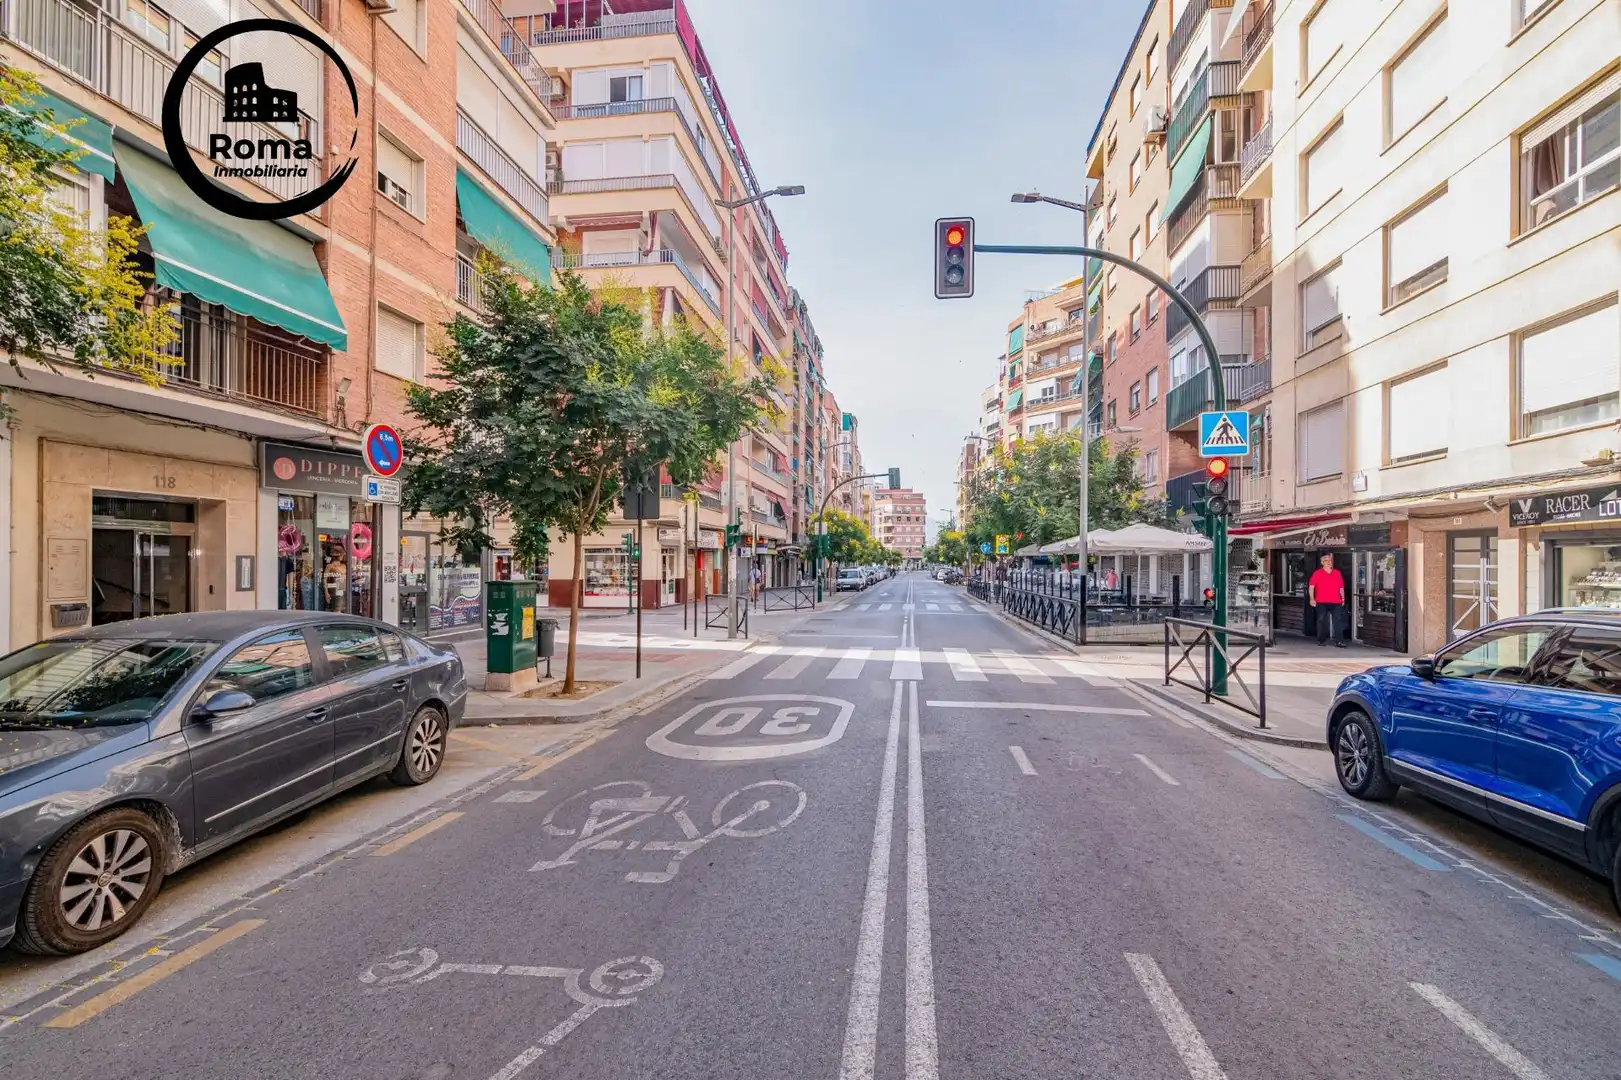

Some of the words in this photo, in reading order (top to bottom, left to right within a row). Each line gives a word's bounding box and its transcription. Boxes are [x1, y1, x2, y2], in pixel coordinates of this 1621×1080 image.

[152, 475, 177, 489] 118
[1545, 494, 1592, 514] RACER
[1512, 512, 1539, 520] VICEROY
